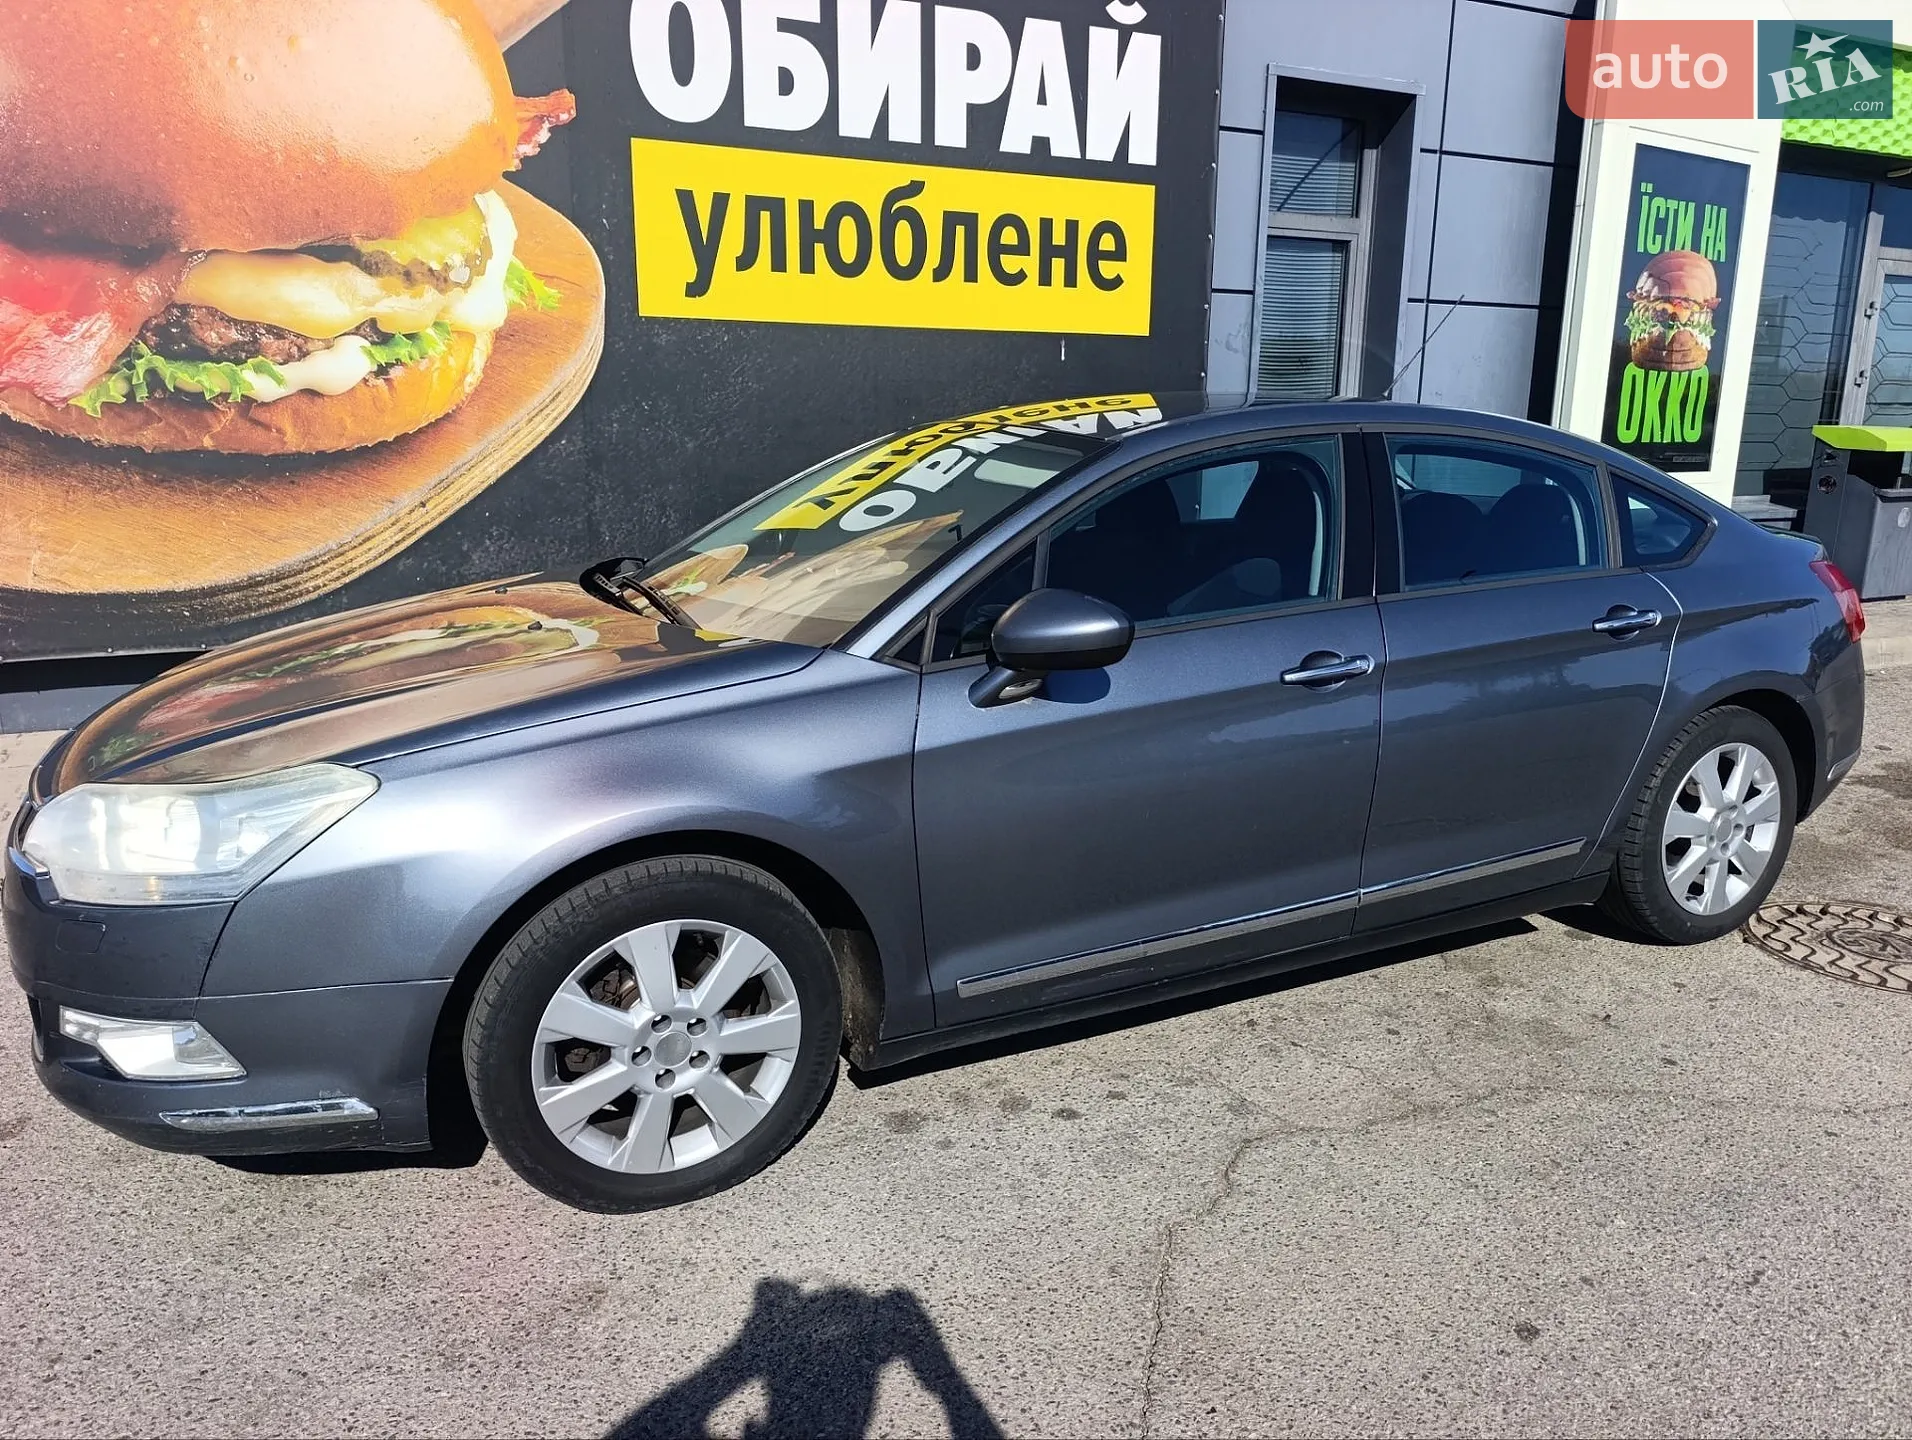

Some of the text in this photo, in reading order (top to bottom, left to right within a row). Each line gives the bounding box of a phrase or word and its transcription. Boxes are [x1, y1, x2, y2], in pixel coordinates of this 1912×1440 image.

[630, 0, 1161, 166] ОБИРАЙ
[675, 180, 1127, 298] улюблене
[1637, 182, 1727, 262] ЇСТИ НА
[1617, 361, 1709, 443] ОККО
